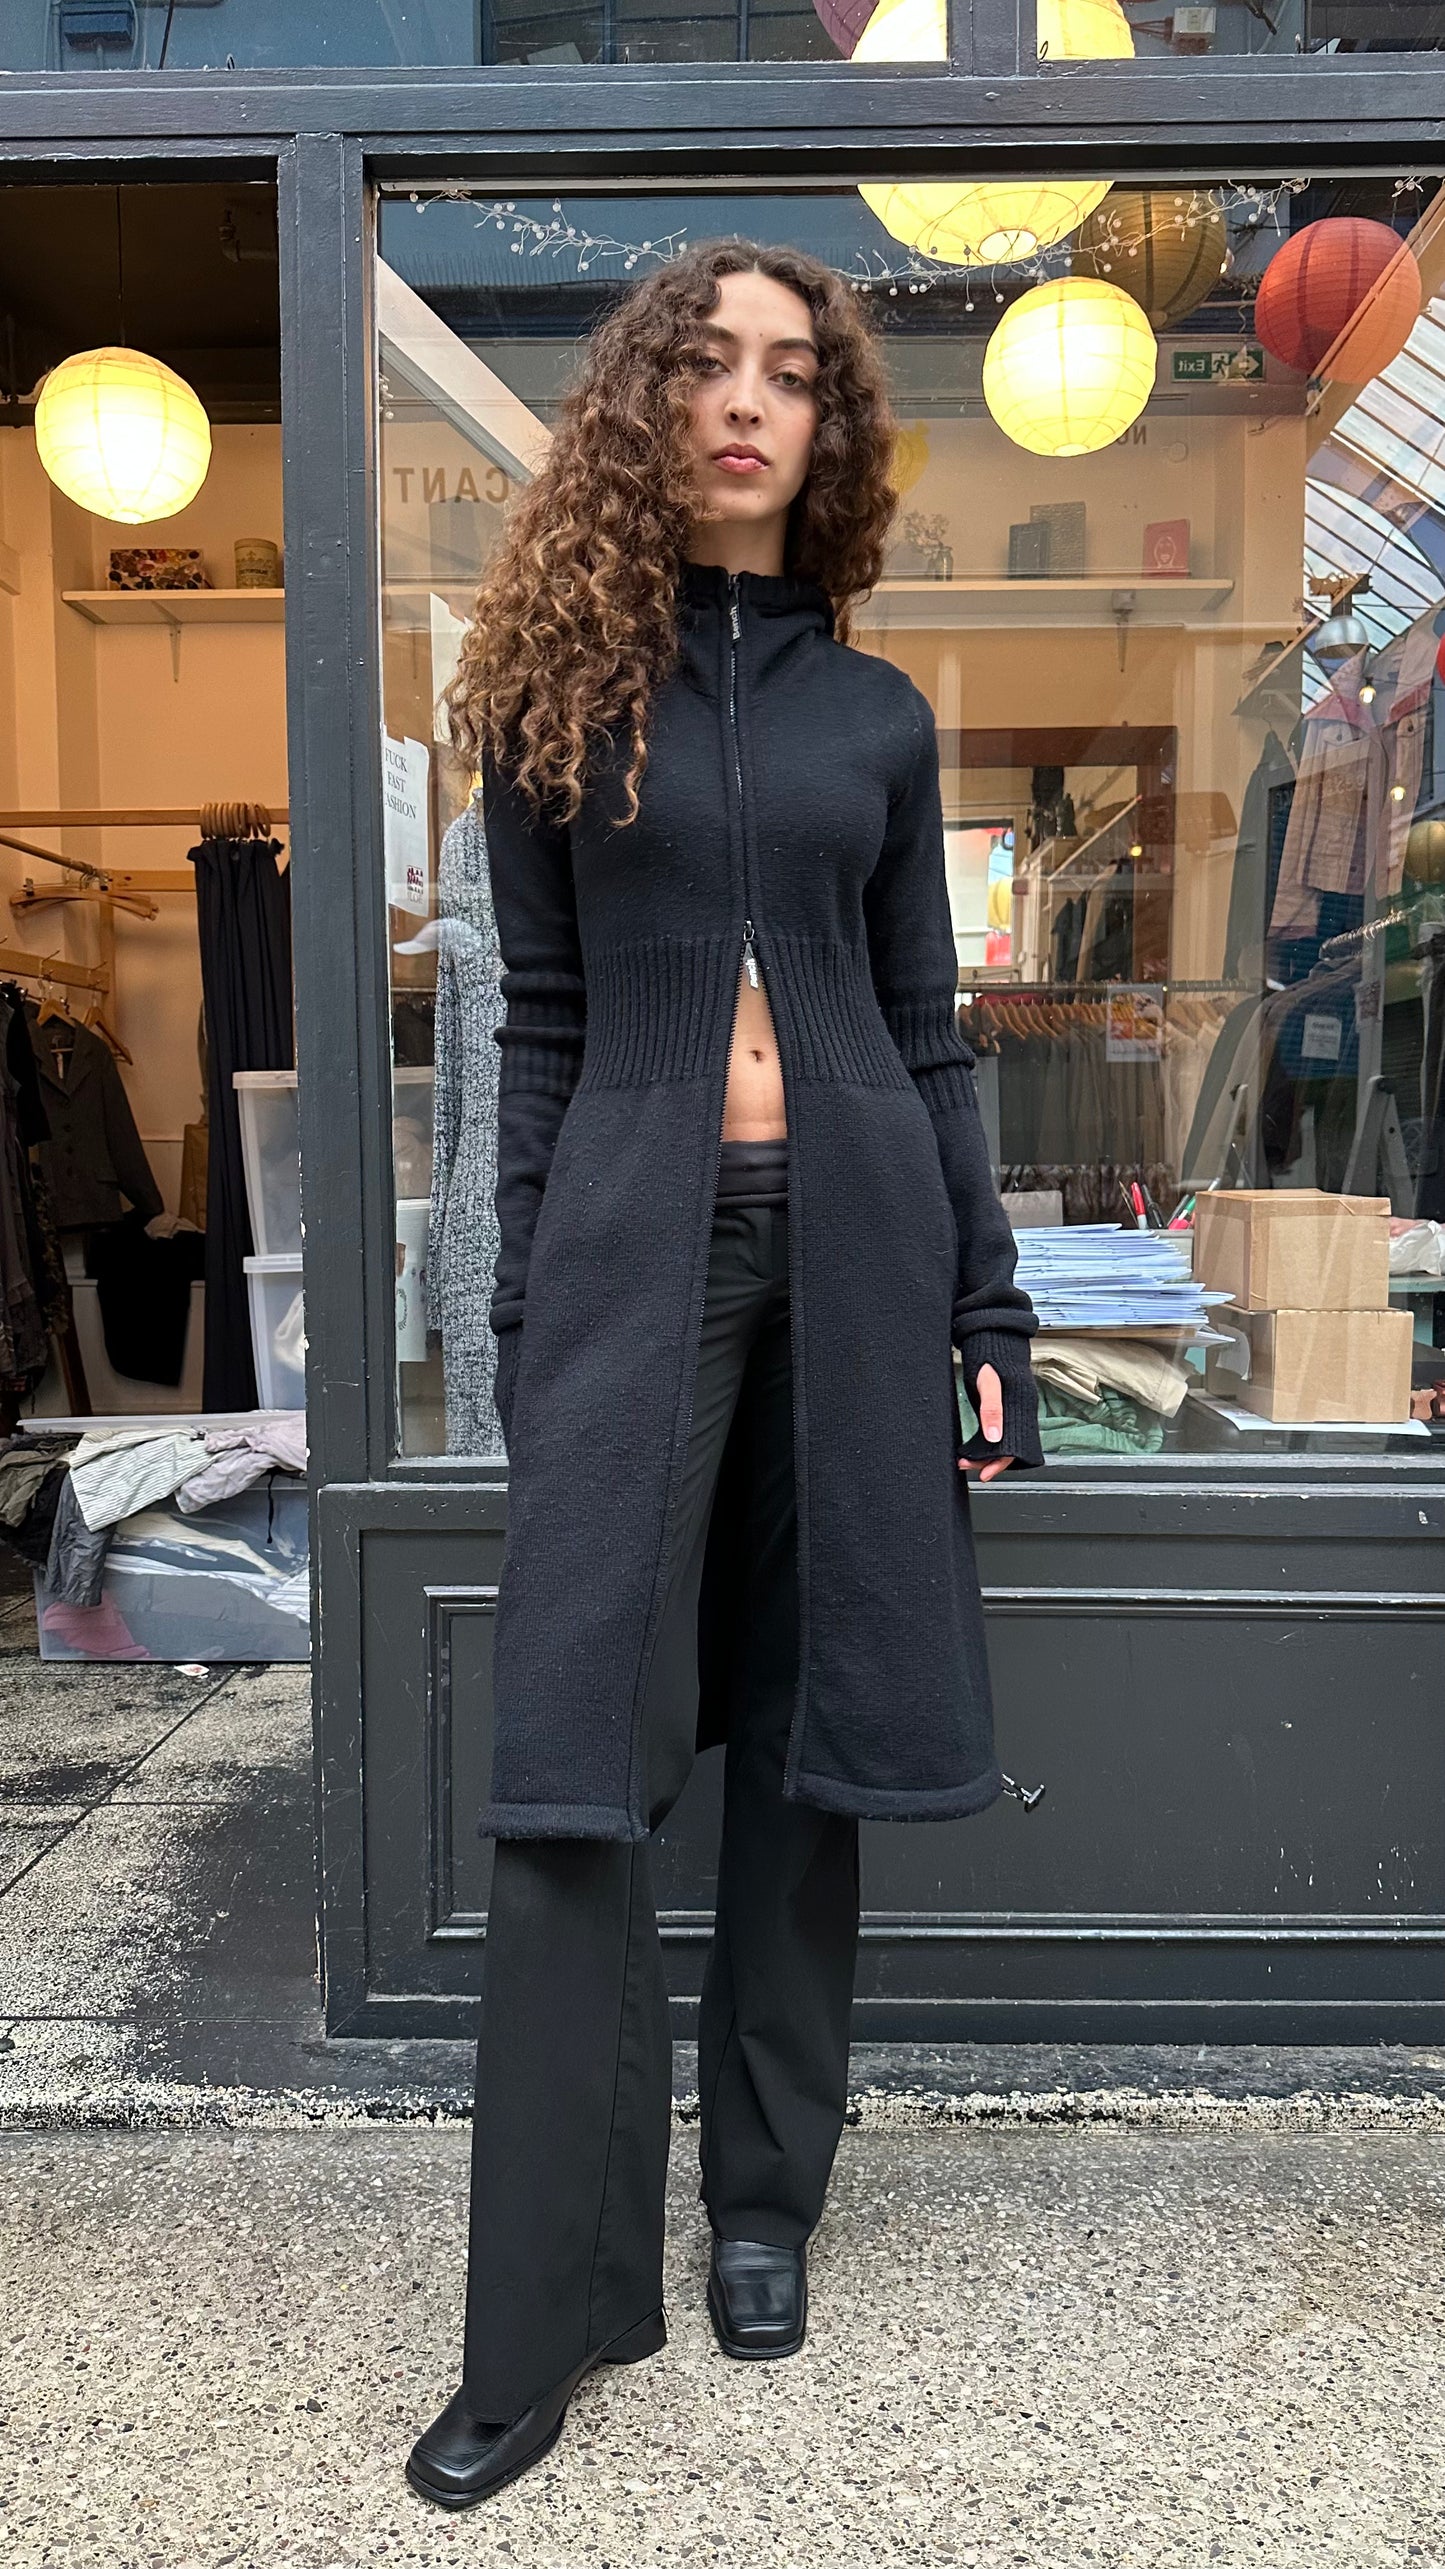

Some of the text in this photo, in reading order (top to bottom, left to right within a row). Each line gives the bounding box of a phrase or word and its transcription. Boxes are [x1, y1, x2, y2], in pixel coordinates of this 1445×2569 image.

[729, 605, 741, 640] Bench
[384, 747, 408, 773] FUCK
[384, 791, 417, 819] ASHION
